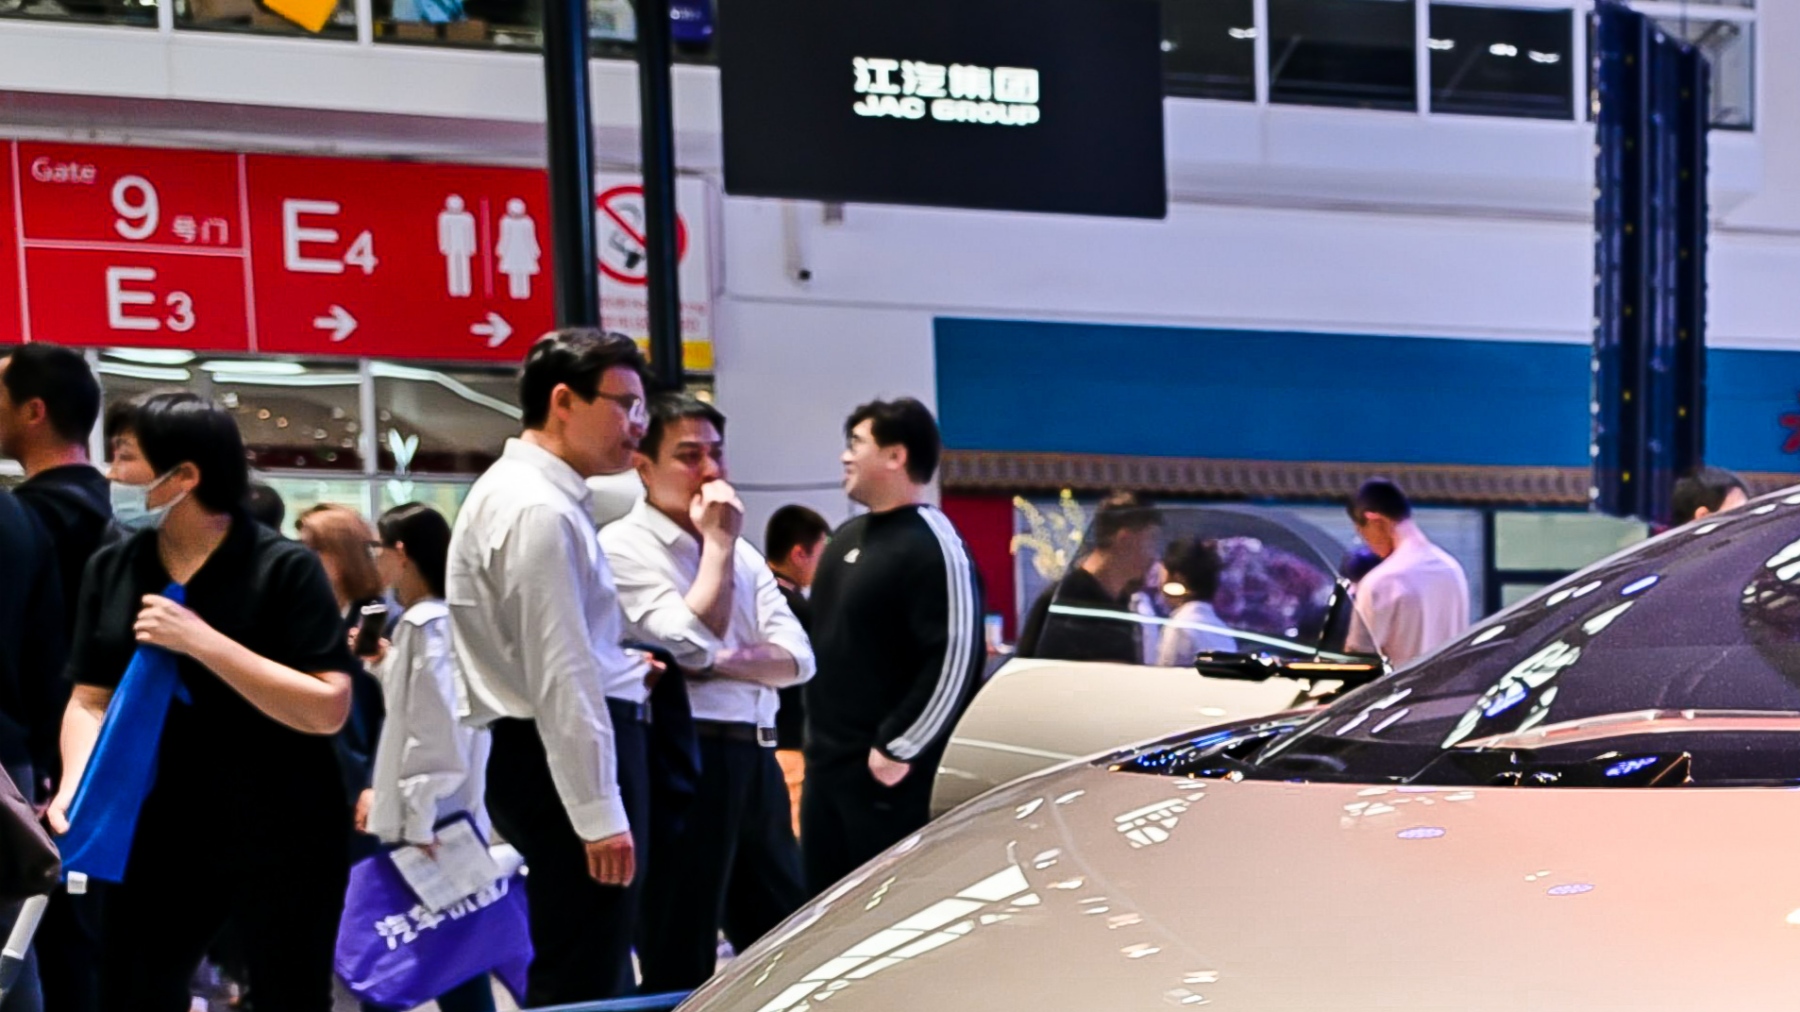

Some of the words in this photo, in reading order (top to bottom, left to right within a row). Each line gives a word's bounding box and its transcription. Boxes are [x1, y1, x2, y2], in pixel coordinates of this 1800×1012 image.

[853, 56, 1040, 104] 江汽集团
[853, 94, 926, 120] JAC
[931, 98, 1041, 126] GROUP
[31, 156, 97, 184] Gate
[110, 174, 160, 240] 9
[283, 198, 379, 275] E4
[106, 266, 196, 333] E3
